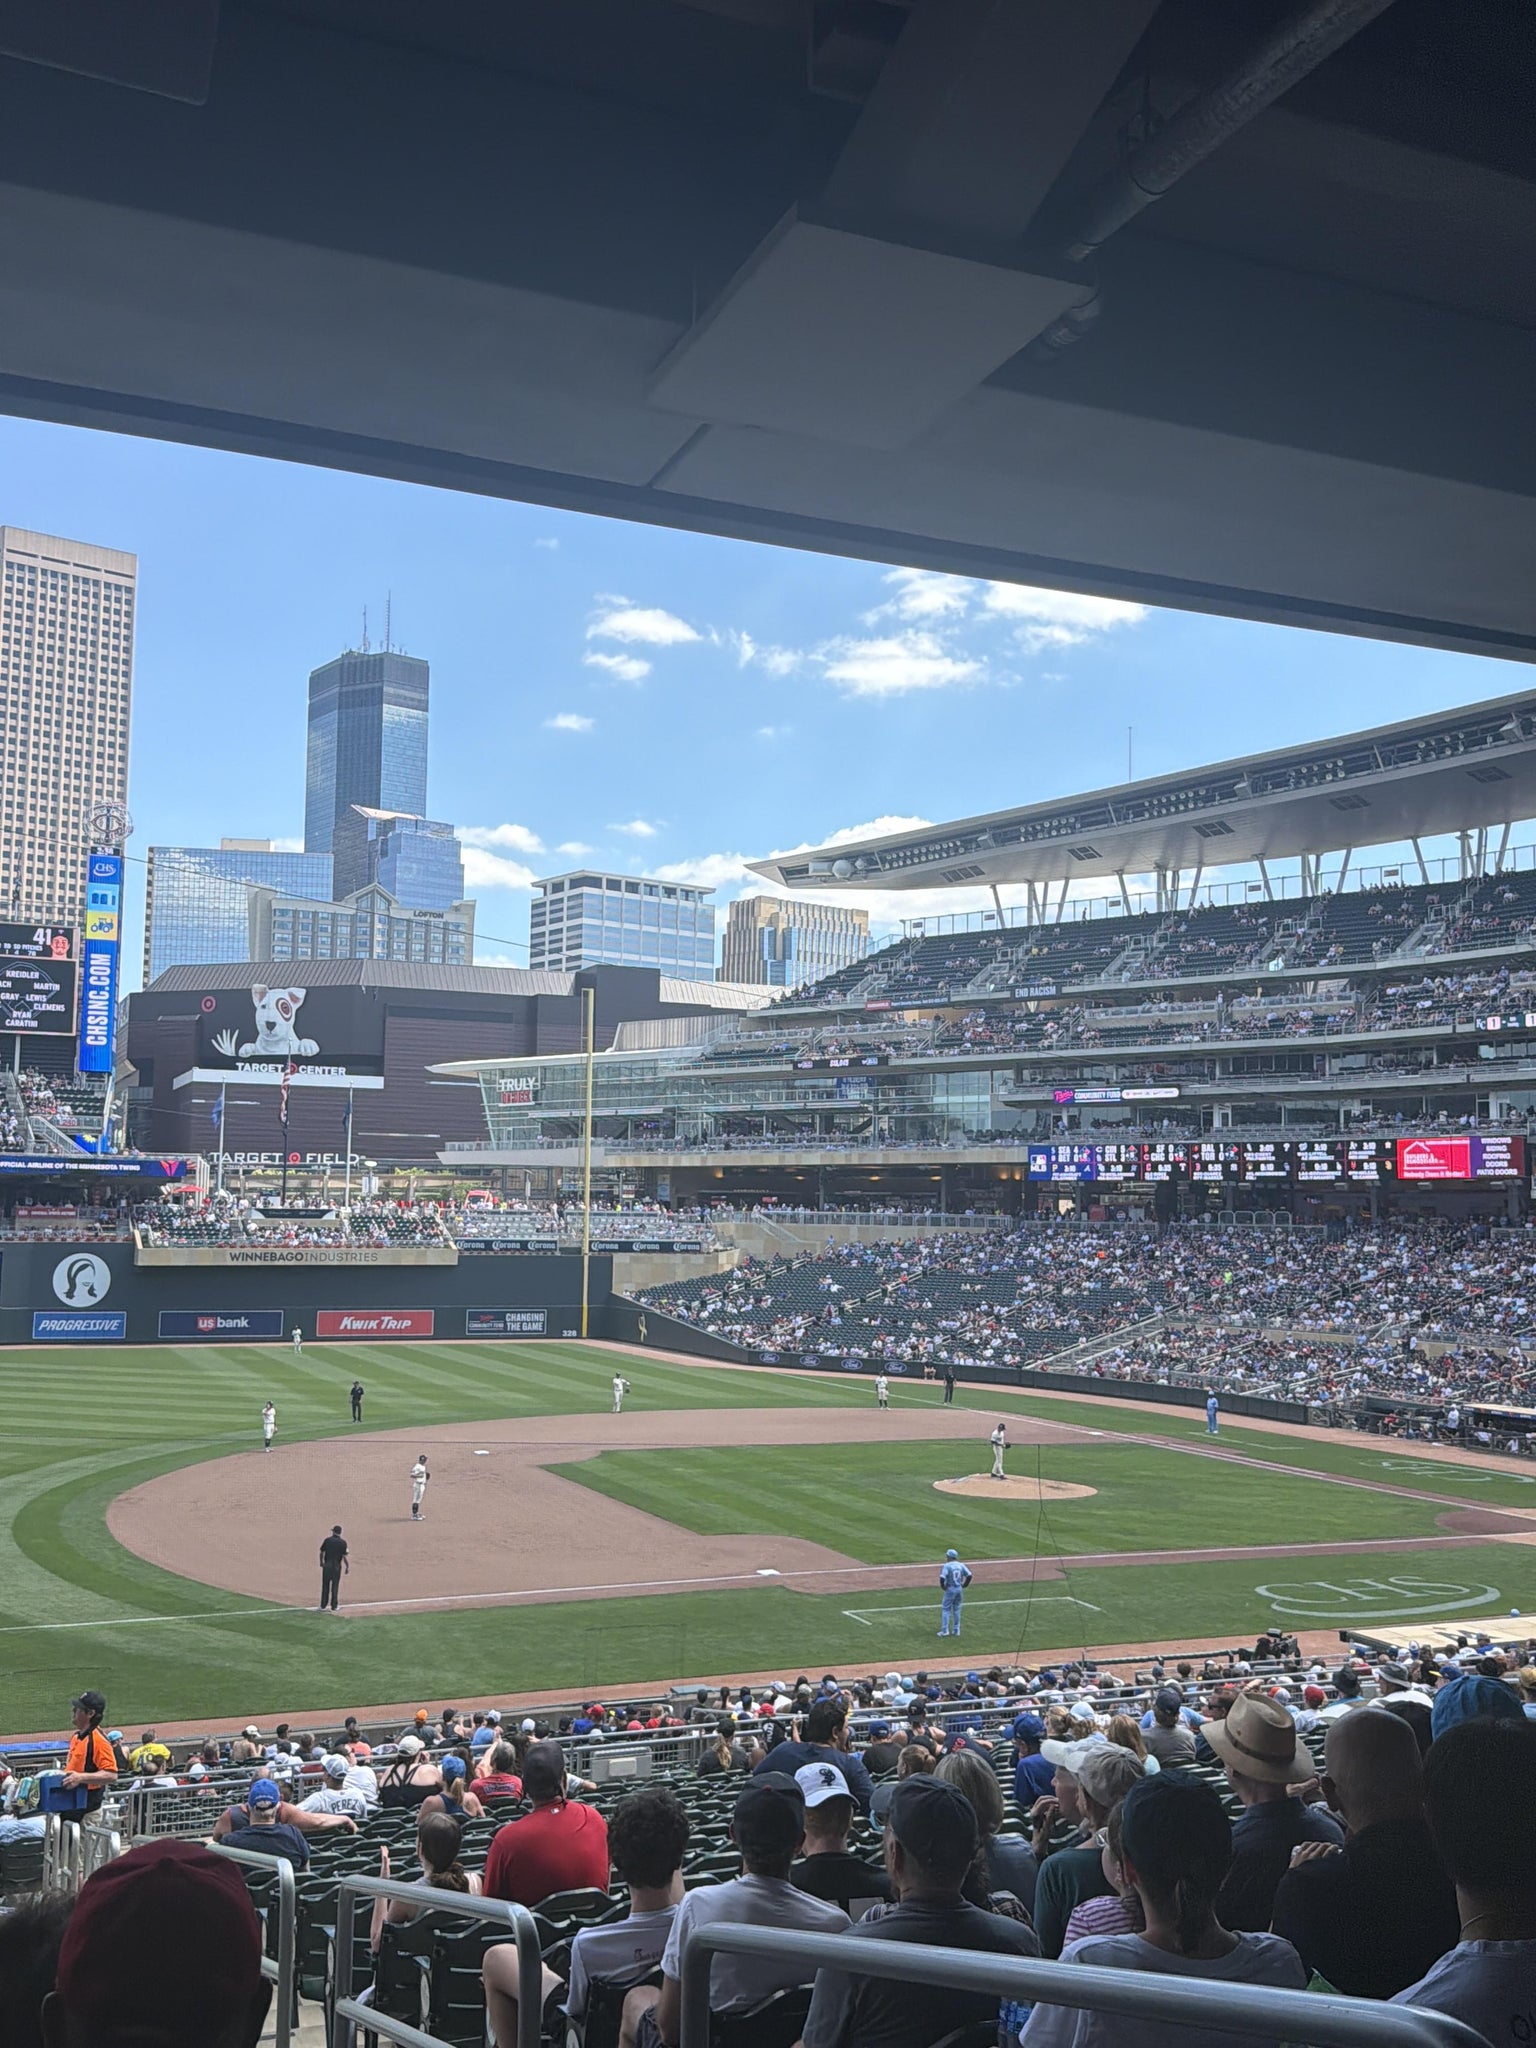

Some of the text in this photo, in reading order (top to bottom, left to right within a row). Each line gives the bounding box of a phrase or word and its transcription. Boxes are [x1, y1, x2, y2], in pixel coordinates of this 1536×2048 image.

[413, 910, 445, 919] LOFTON
[33, 928, 52, 946] 41
[6, 970, 40, 979] KREIDLER
[33, 982, 60, 991] MARTIN
[1015, 986, 1056, 998] END RACISM
[26, 994, 47, 1002] LEWIS
[86, 953, 112, 1047] CHSINC.COM
[33, 1003, 65, 1012] CLEMENS
[13, 1011, 32, 1019] RYAN
[5, 1019, 38, 1028] CARATINI
[236, 1062, 347, 1076] TARGET CENTER
[499, 1076, 537, 1091] TRULY
[209, 1152, 360, 1165] TARGET FIELD
[456, 1240, 485, 1249] Corona
[492, 1240, 521, 1249] Corona
[527, 1241, 556, 1249] Corona
[591, 1241, 619, 1250] Corona
[632, 1241, 660, 1250] Corona
[672, 1241, 701, 1251] Corona
[229, 1252, 379, 1262] WINNEBAGO INDUSTRIES
[217, 1316, 249, 1328] bank
[505, 1313, 545, 1322] CHANGING
[38, 1319, 121, 1331] PROGRESSIVE
[339, 1316, 412, 1330] KWIK TRIP
[507, 1322, 543, 1331] THE GAME
[1254, 1576, 1471, 1604] CHS
[330, 1798, 358, 1814] PEREZ
